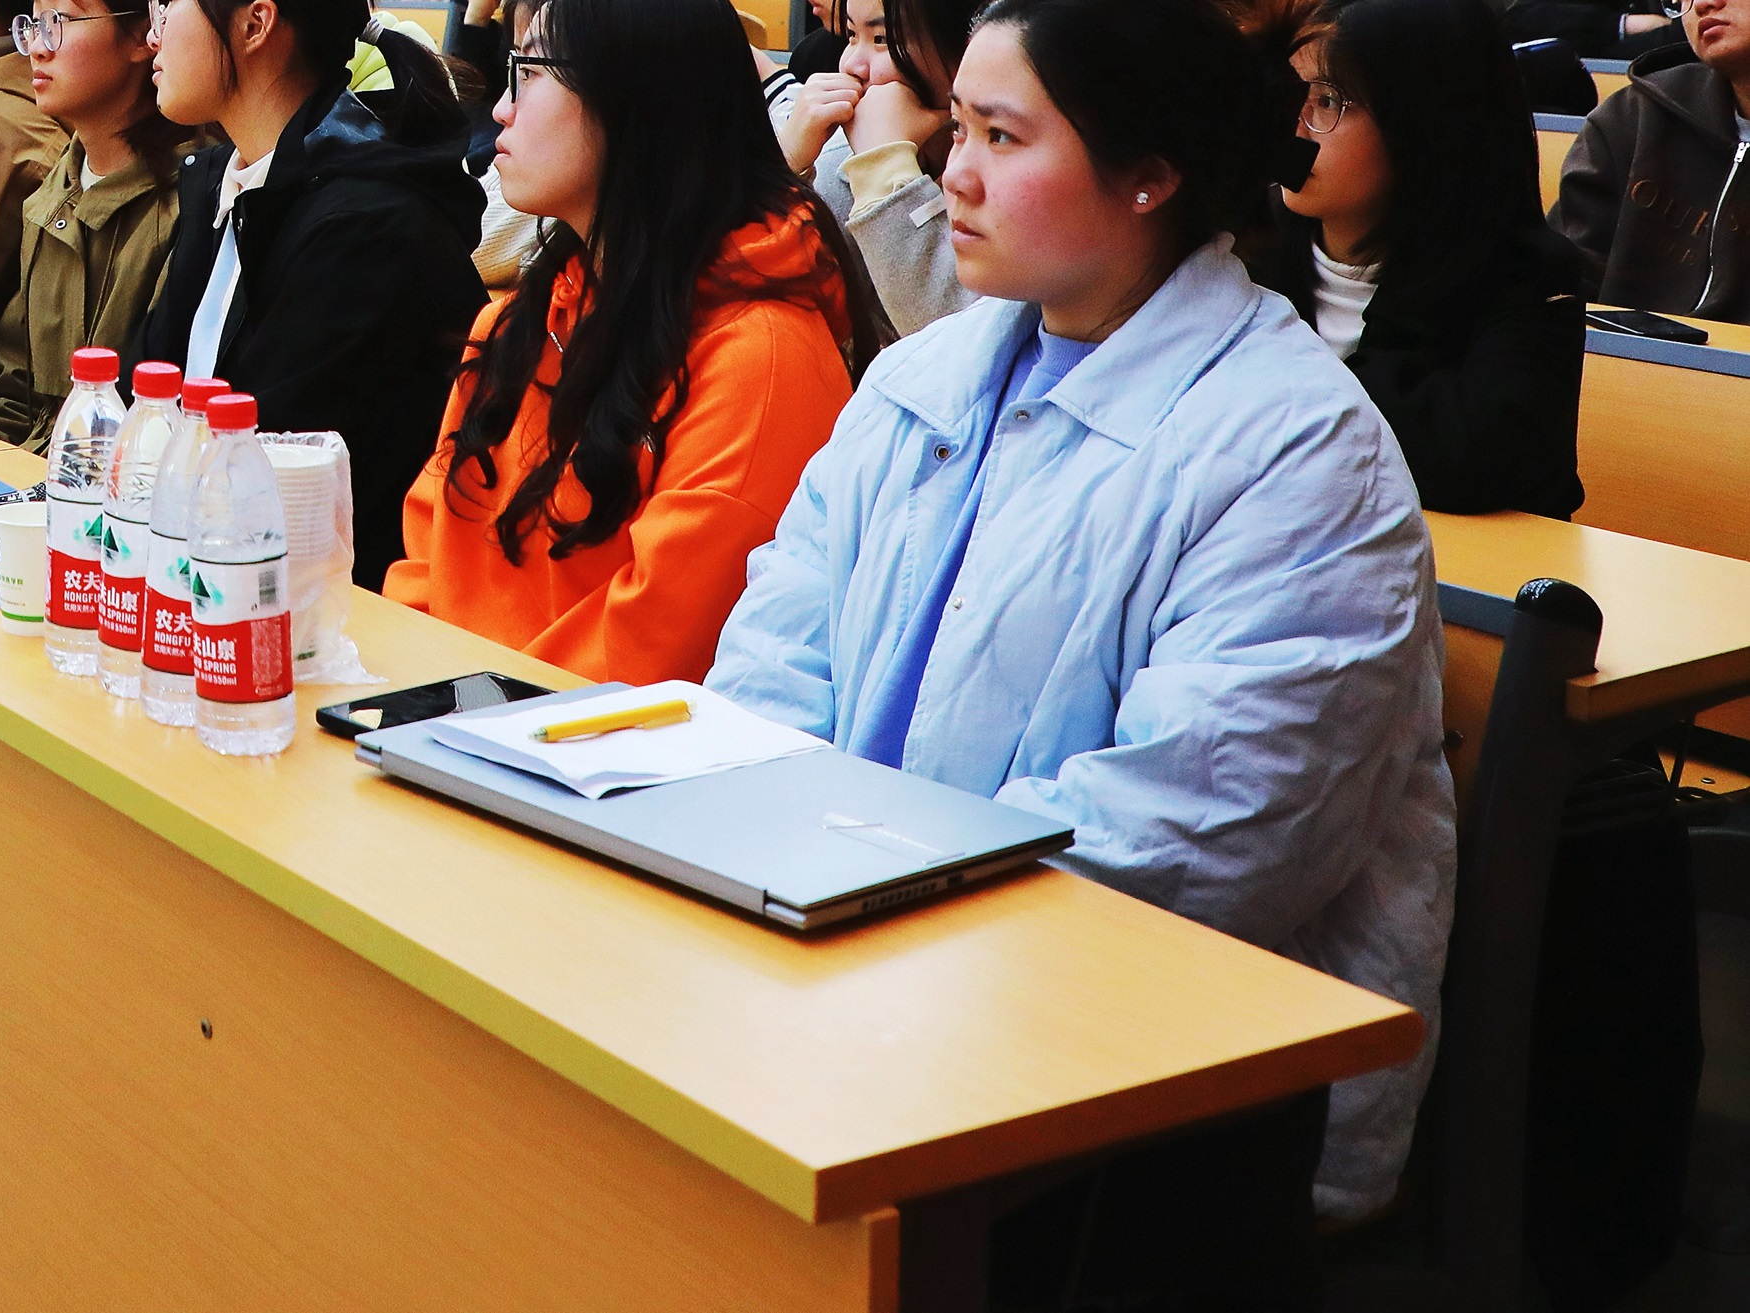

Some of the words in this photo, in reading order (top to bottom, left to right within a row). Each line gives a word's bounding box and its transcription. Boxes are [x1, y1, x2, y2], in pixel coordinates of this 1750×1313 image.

[64, 569, 102, 592] 农夫
[63, 590, 100, 604] NONGFU
[107, 607, 137, 625] SPRING
[155, 608, 192, 634] 农夫
[154, 630, 191, 647] NONGFU
[203, 659, 237, 675] SPRING
